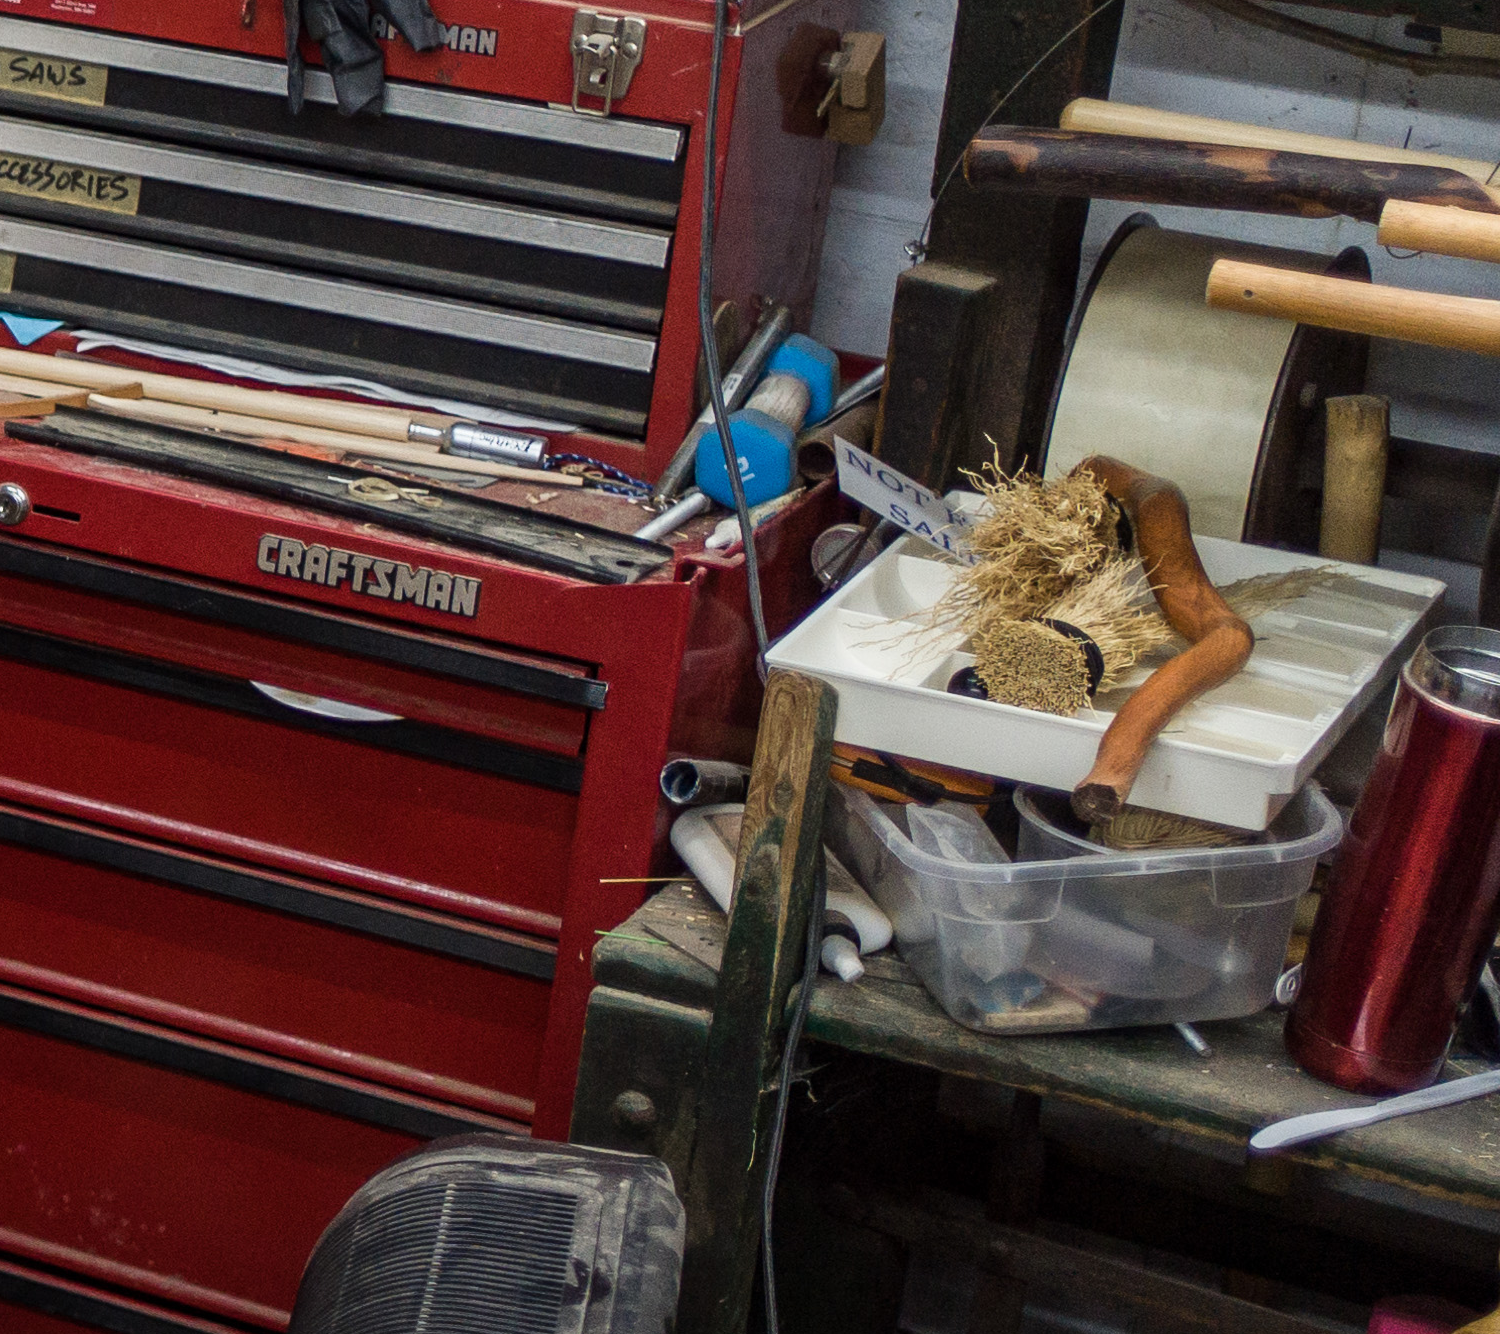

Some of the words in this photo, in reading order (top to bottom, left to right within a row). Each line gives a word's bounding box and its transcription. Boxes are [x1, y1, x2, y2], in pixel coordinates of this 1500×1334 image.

[9, 57, 86, 86] SAWS
[845, 447, 931, 507] NOT
[257, 533, 482, 617] CRAFTSMAN
